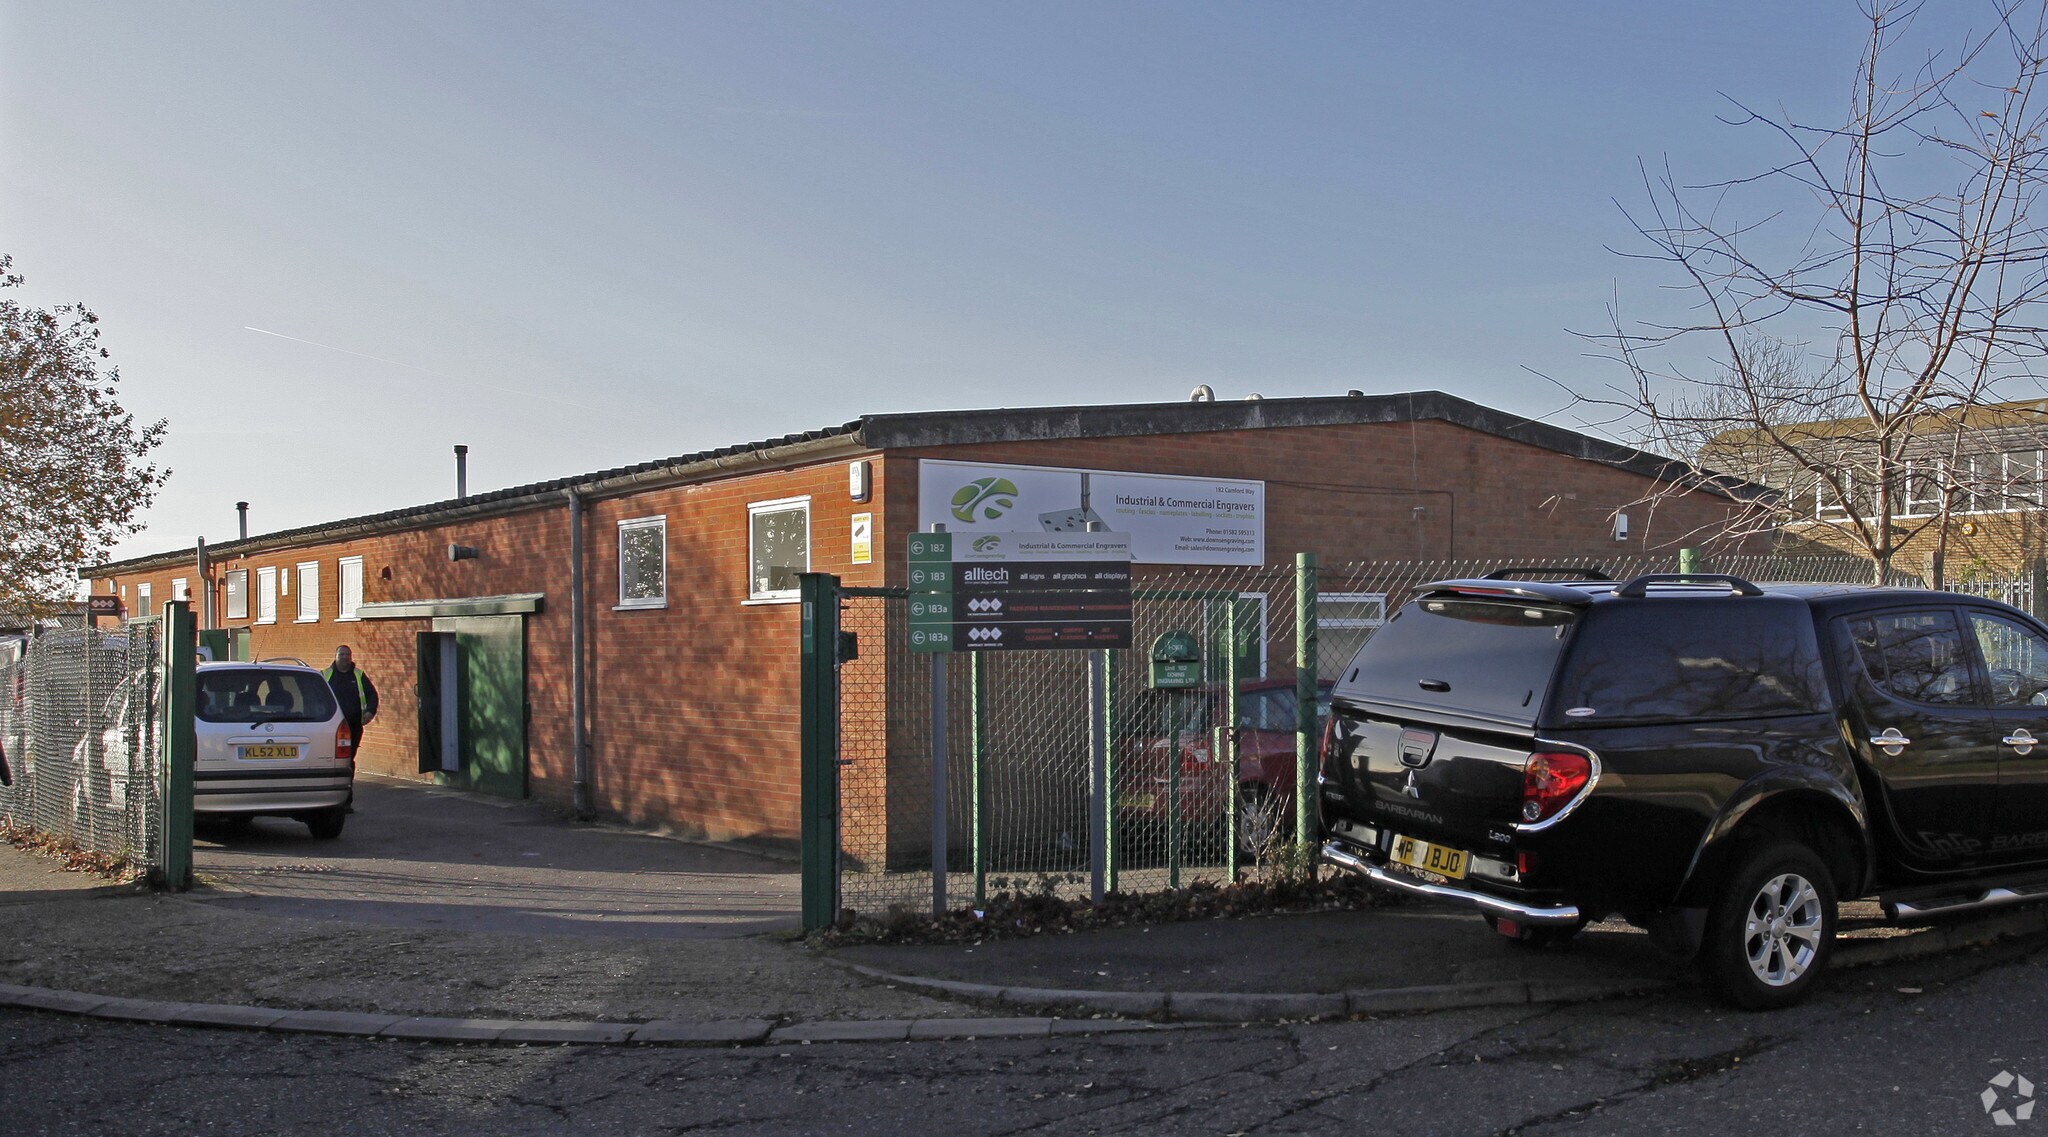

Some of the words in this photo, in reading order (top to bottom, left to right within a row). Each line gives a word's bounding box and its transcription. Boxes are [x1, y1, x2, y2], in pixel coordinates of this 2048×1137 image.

[1245, 488, 1256, 496] Way
[1115, 494, 1157, 507] Industrial
[1158, 498, 1165, 507] &
[1166, 497, 1215, 510] Commercial
[1216, 500, 1255, 513] Engravers
[930, 544, 945, 552] 182
[930, 572, 946, 580] 183
[964, 567, 1009, 580] alltech
[1062, 573, 1087, 581] graphics
[928, 604, 948, 613] 183a
[928, 632, 948, 642] 183a
[245, 747, 274, 758] KL52
[276, 747, 298, 757] XLD
[1375, 800, 1443, 824] BARBARIAN
[1489, 830, 1511, 843] L200
